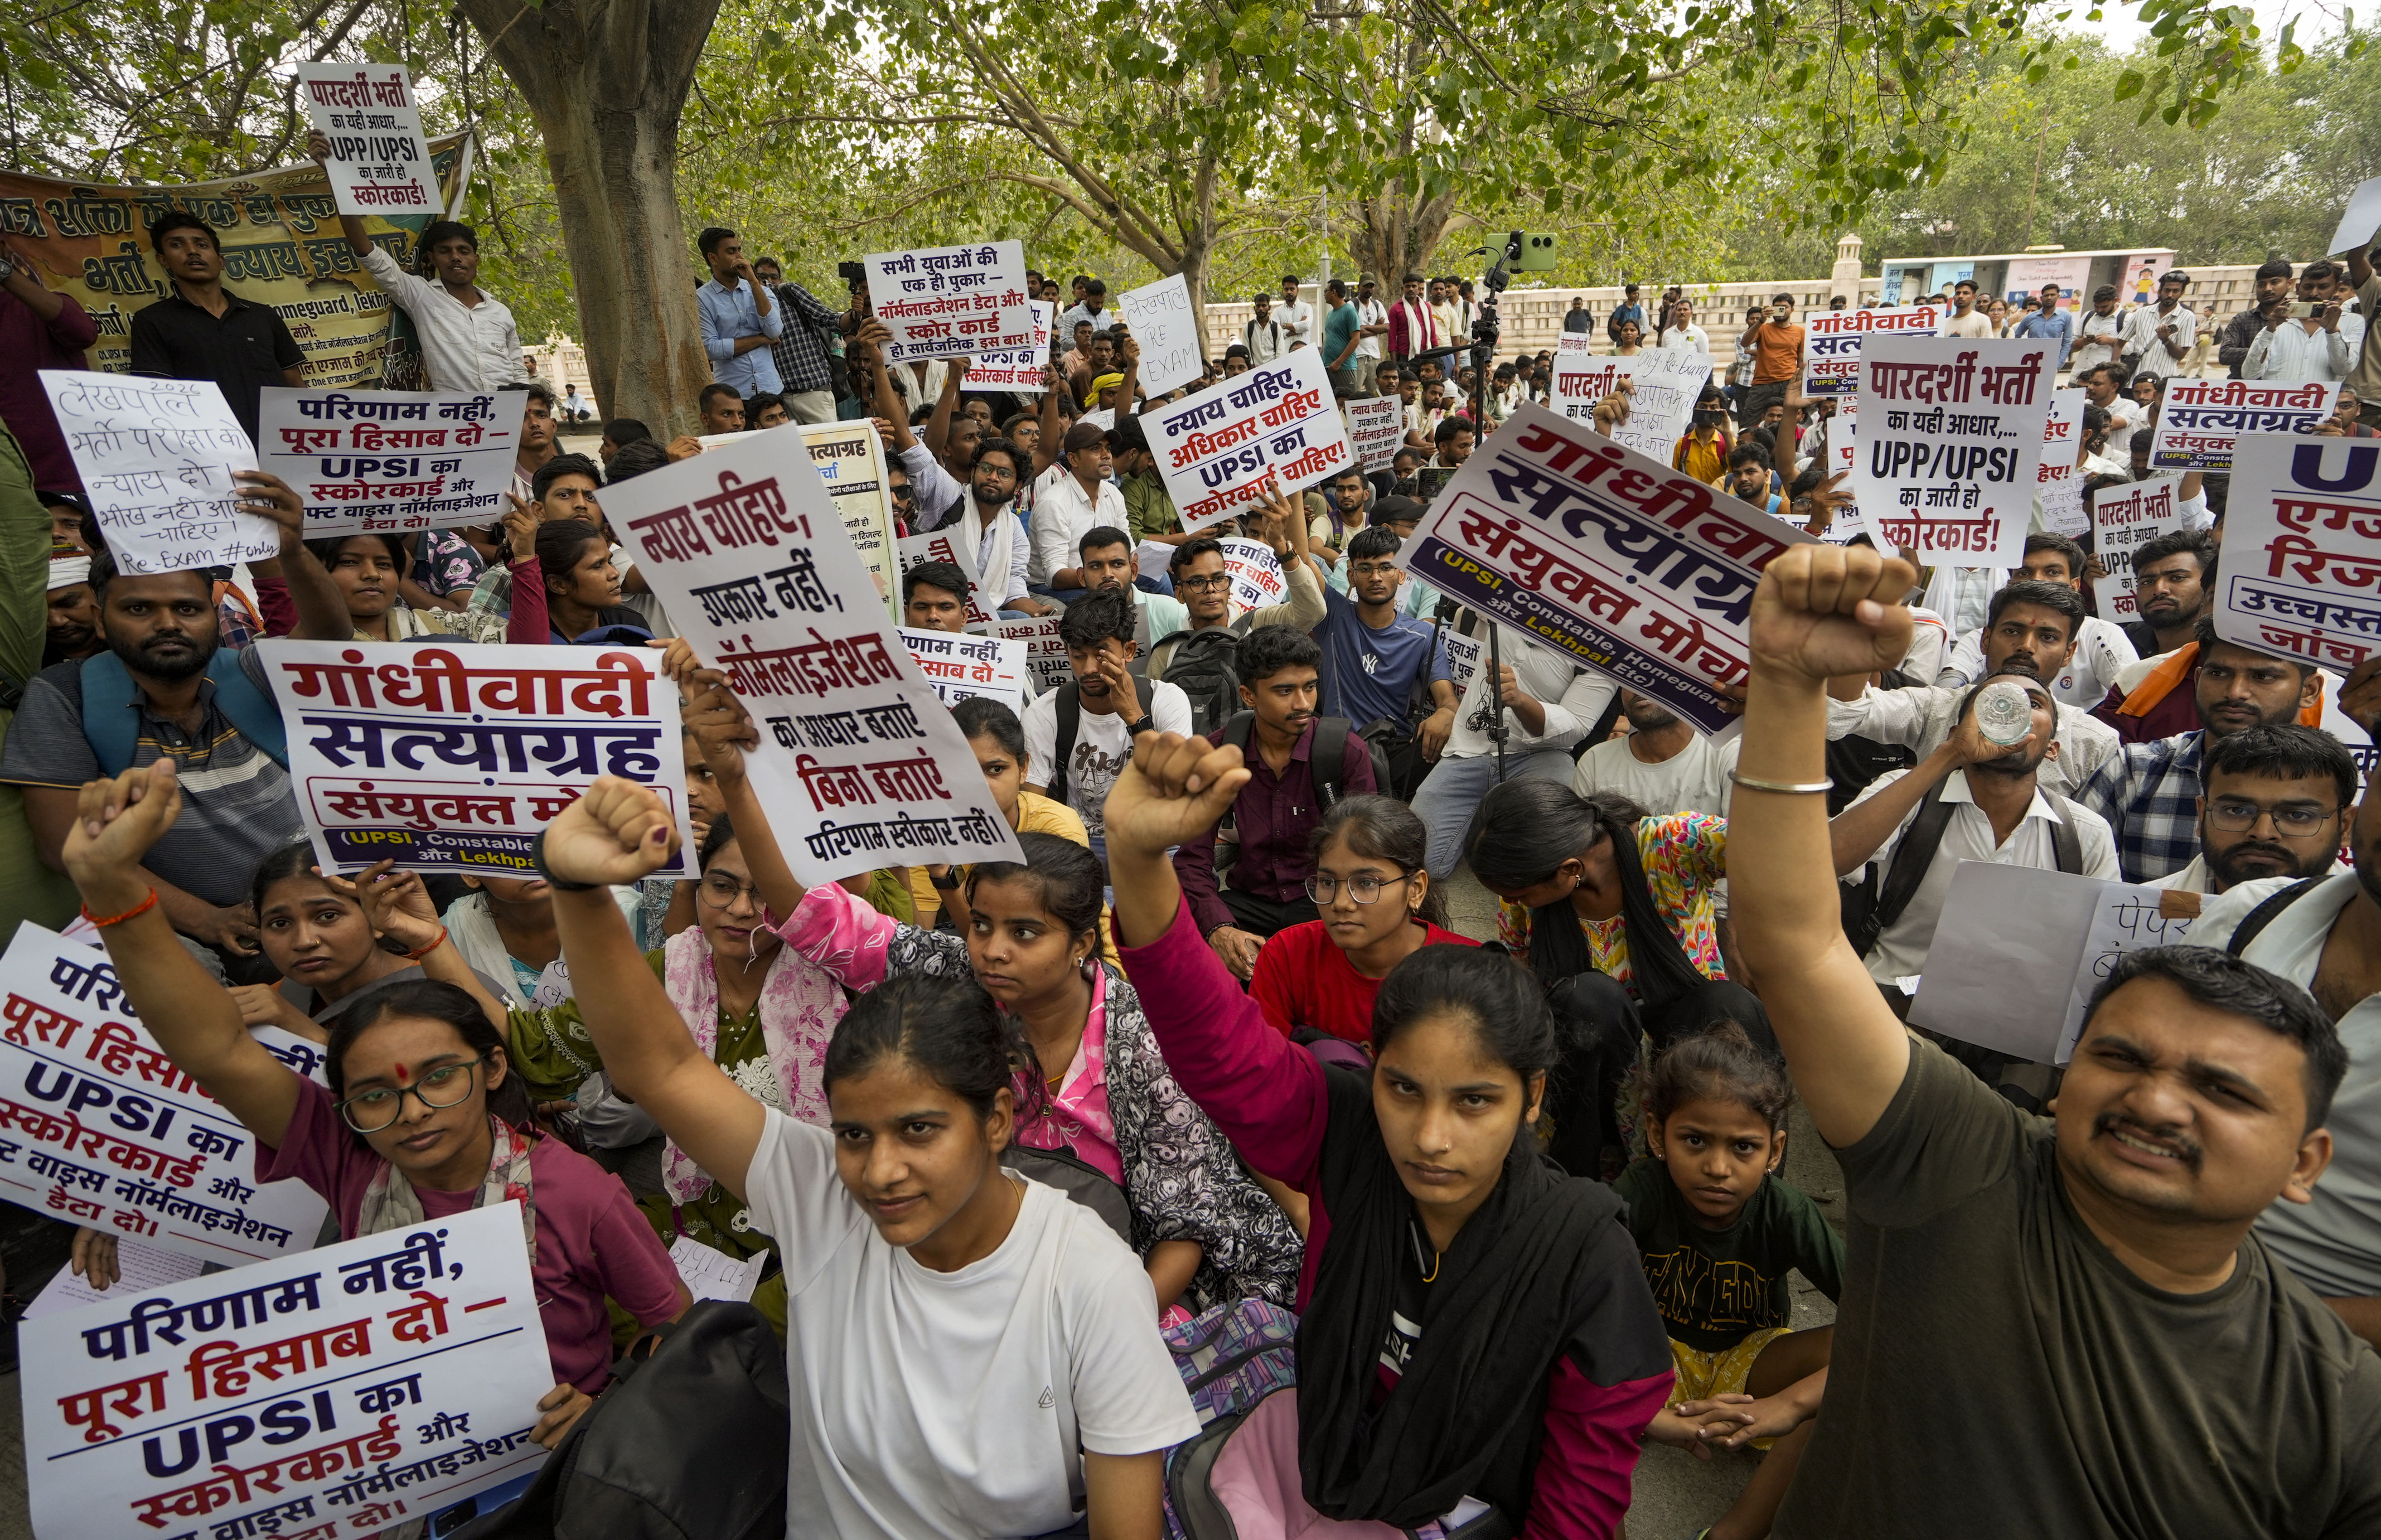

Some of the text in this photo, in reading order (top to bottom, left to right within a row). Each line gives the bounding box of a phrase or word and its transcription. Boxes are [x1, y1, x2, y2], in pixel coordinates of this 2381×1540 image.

[308, 72, 407, 108] पारदर्शी भर्ती
[330, 110, 365, 129] का यही
[330, 137, 419, 161] UPP/UPSI
[358, 163, 405, 180] का जारी हो
[351, 178, 427, 205] स्कोरकार्ड!
[881, 246, 998, 275] सभी युवाओं की
[901, 273, 986, 293] एक ही पुकार
[878, 288, 1024, 319] नॉर्मलाइजेशन डेटा और
[905, 312, 1000, 341] स्कोर कार्ड
[1812, 307, 1938, 334] गांधीवादी
[890, 342, 904, 358] हो
[907, 337, 974, 355] सार्वजनिक
[979, 335, 999, 349] इस
[1002, 333, 1030, 345] बार!
[1145, 325, 1167, 348] RE
[1146, 343, 1197, 382] EXAM
[1870, 351, 2044, 405] पारदर्शी भर्ती
[59, 378, 200, 418] लेखपाल
[297, 394, 496, 421] परिणाम नहीं,
[1163, 368, 1303, 438] न्याय चाहिए,
[1351, 405, 1369, 415] न्याय
[1567, 405, 1578, 418] का
[2171, 382, 2328, 410] गांधीवादी
[1168, 388, 1322, 468] अधिकार चाहिए
[1357, 418, 1378, 428] उपकार
[1888, 406, 1944, 434] का यही
[128, 418, 217, 457] परीक्षा
[279, 422, 485, 453] पूरा हिसाब दो
[1366, 441, 1382, 451] आधार
[321, 458, 462, 478] UPSI का
[1199, 427, 1307, 487] UPSI का
[1281, 440, 1347, 481] चाहिए!
[1871, 440, 2019, 483] UPP/UPSI
[93, 470, 165, 496] न्याय
[309, 475, 475, 501] स्कोरकार्ड और
[1900, 482, 1981, 510] का जारी हो
[344, 492, 499, 518] वाइस नॉर्मलाइजेशन
[627, 470, 813, 564] न्याय चाहिए,
[2098, 484, 2171, 527] पारदर्शी भर्ती
[361, 518, 396, 530] डेटा
[861, 517, 869, 527] हो
[1879, 507, 2000, 553] स्कोरकार्ड!
[2106, 527, 2132, 546] का यही
[1247, 565, 1281, 595] चाहिए
[1458, 508, 1642, 626] संयुक्त
[690, 547, 844, 628] उपकार नहीं,
[1239, 583, 1261, 603] का
[2122, 578, 2132, 589] का
[1512, 587, 1617, 656] Constable,
[960, 641, 1003, 664] नहीं,
[1487, 597, 1657, 687] और Lekhpal Etc)
[716, 628, 903, 699] नॉर्मलाइजेशन
[971, 662, 994, 682] दो
[282, 648, 655, 718] गांधीवादी
[766, 696, 928, 748] का आधार बताएं
[797, 747, 952, 812] बिना बताएं
[323, 782, 516, 831] संयुक्त
[805, 819, 891, 861] परिणाम
[890, 811, 957, 850] स्वीकार
[418, 849, 453, 861] और
[2, 991, 83, 1047] पूरा
[24, 1060, 245, 1162] UPSI का
[28, 1149, 293, 1248] वाइस नॉर्मलाइजेशन
[46, 1185, 107, 1222] डेटा
[208, 1176, 256, 1205] और
[82, 1228, 463, 1362] परिणाम नहीं,
[57, 1291, 453, 1442] पूरा हिसाब दो
[143, 1373, 423, 1479] UPSI का
[131, 1413, 471, 1528] स्कोरकार्ड और
